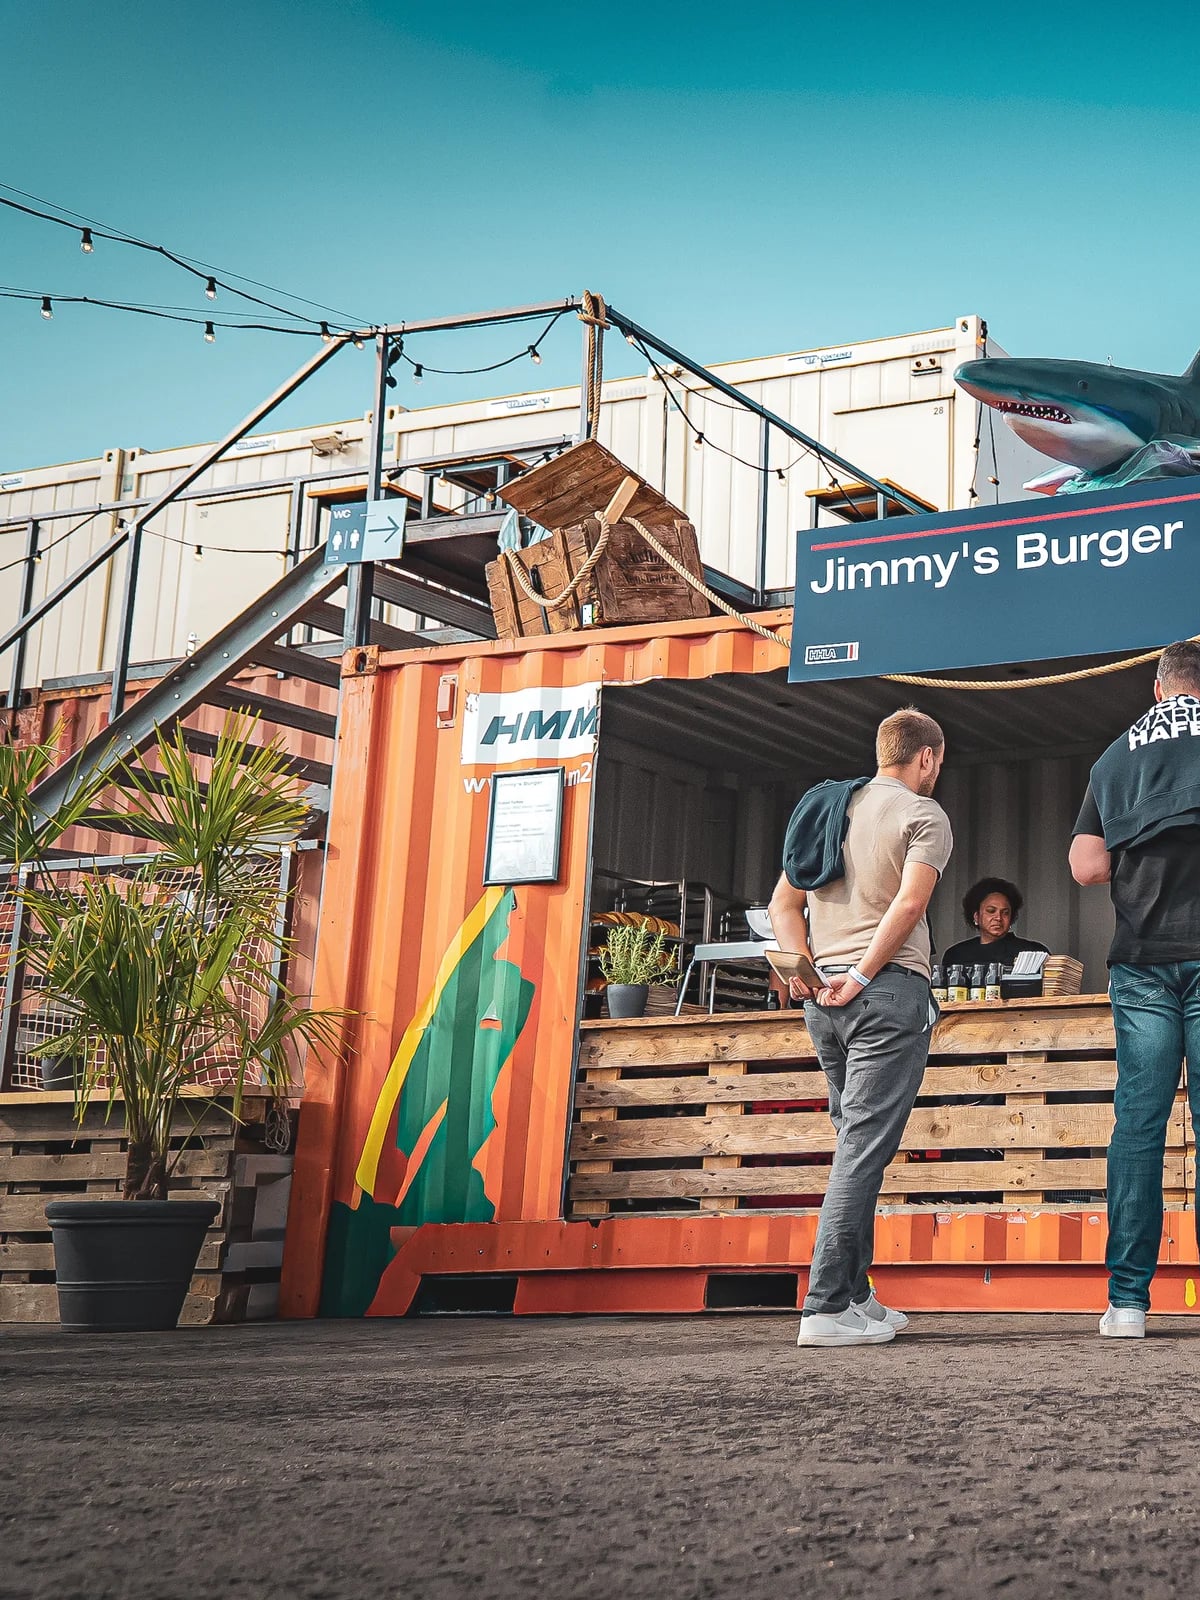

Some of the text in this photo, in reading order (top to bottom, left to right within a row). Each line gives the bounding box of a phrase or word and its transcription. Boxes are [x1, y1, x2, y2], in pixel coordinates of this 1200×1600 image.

[933, 406, 944, 415] 28
[333, 509, 352, 519] WC
[810, 520, 1184, 594] Jimmy's Burger
[480, 704, 598, 745] HMM
